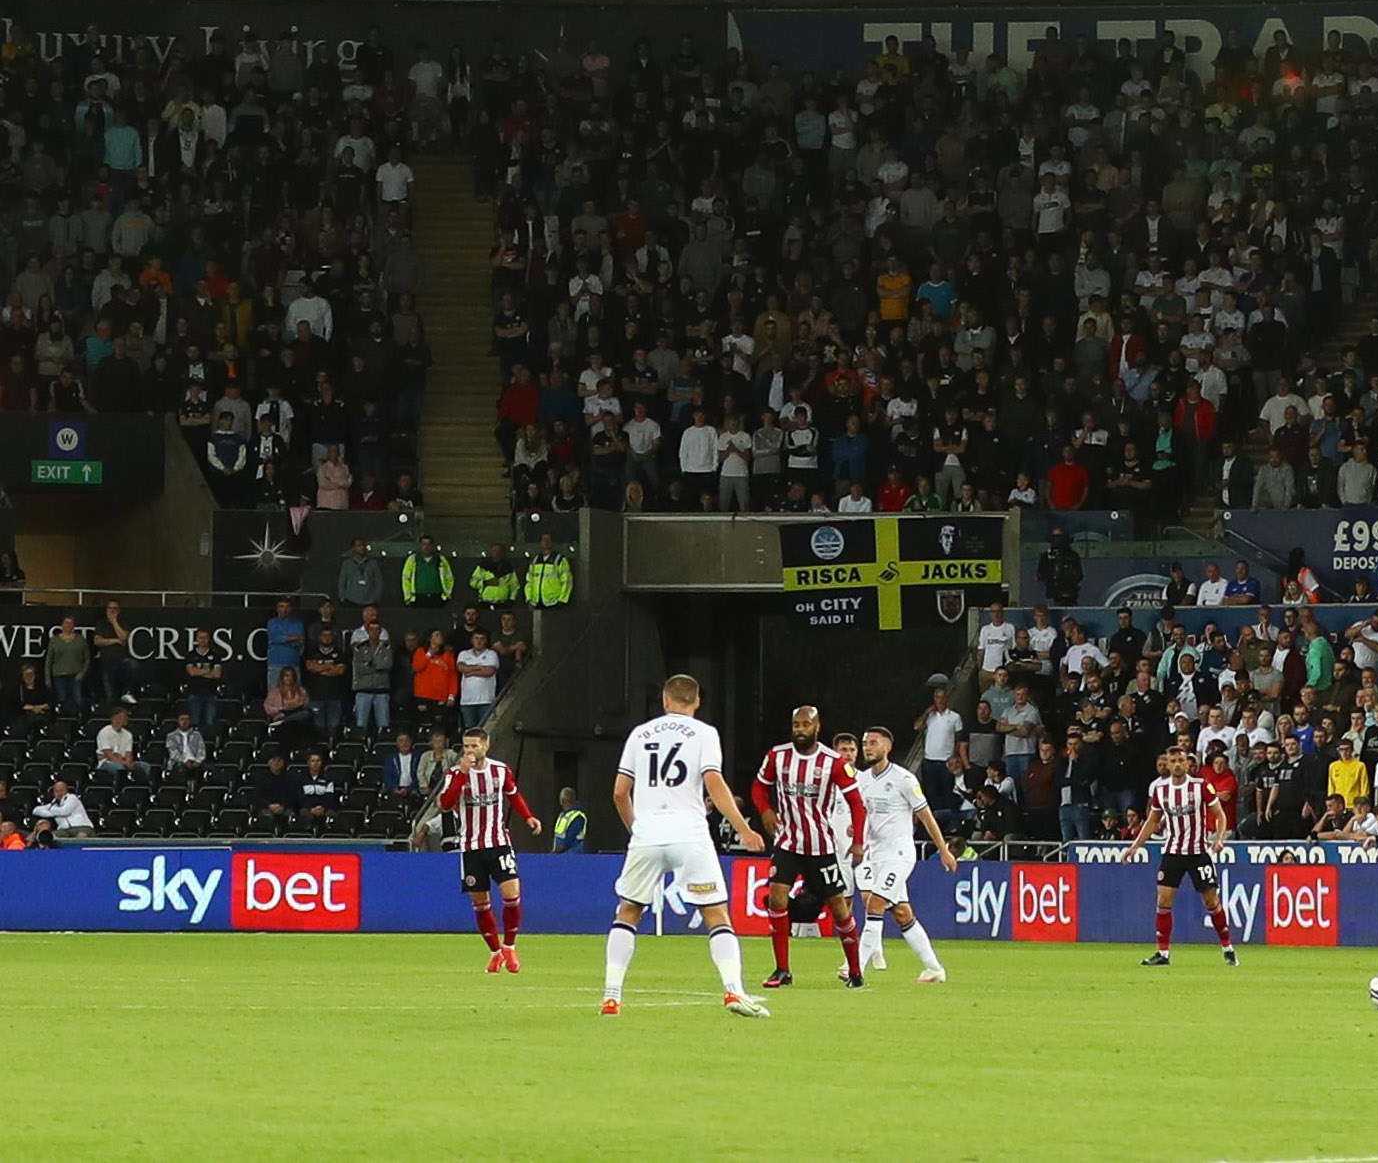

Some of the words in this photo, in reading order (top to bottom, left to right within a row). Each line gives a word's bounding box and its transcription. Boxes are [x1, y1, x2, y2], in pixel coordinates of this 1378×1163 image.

[37, 465, 72, 479] EXIT
[1333, 556, 1378, 570] DEPOS
[796, 567, 862, 586] RISCA
[921, 563, 988, 579] JACKS
[795, 603, 815, 613] OH
[820, 597, 862, 611] CITY
[810, 615, 842, 625] SAID
[644, 742, 687, 787] 16
[499, 854, 516, 870] 16
[820, 864, 839, 885] 17
[884, 872, 896, 887] 8
[1198, 865, 1213, 881] 19
[118, 856, 222, 923] sky
[245, 854, 346, 912] bet
[955, 866, 1007, 937] sky
[1019, 870, 1071, 924] bet
[1204, 869, 1260, 942] ky
[1272, 873, 1330, 929] bet
